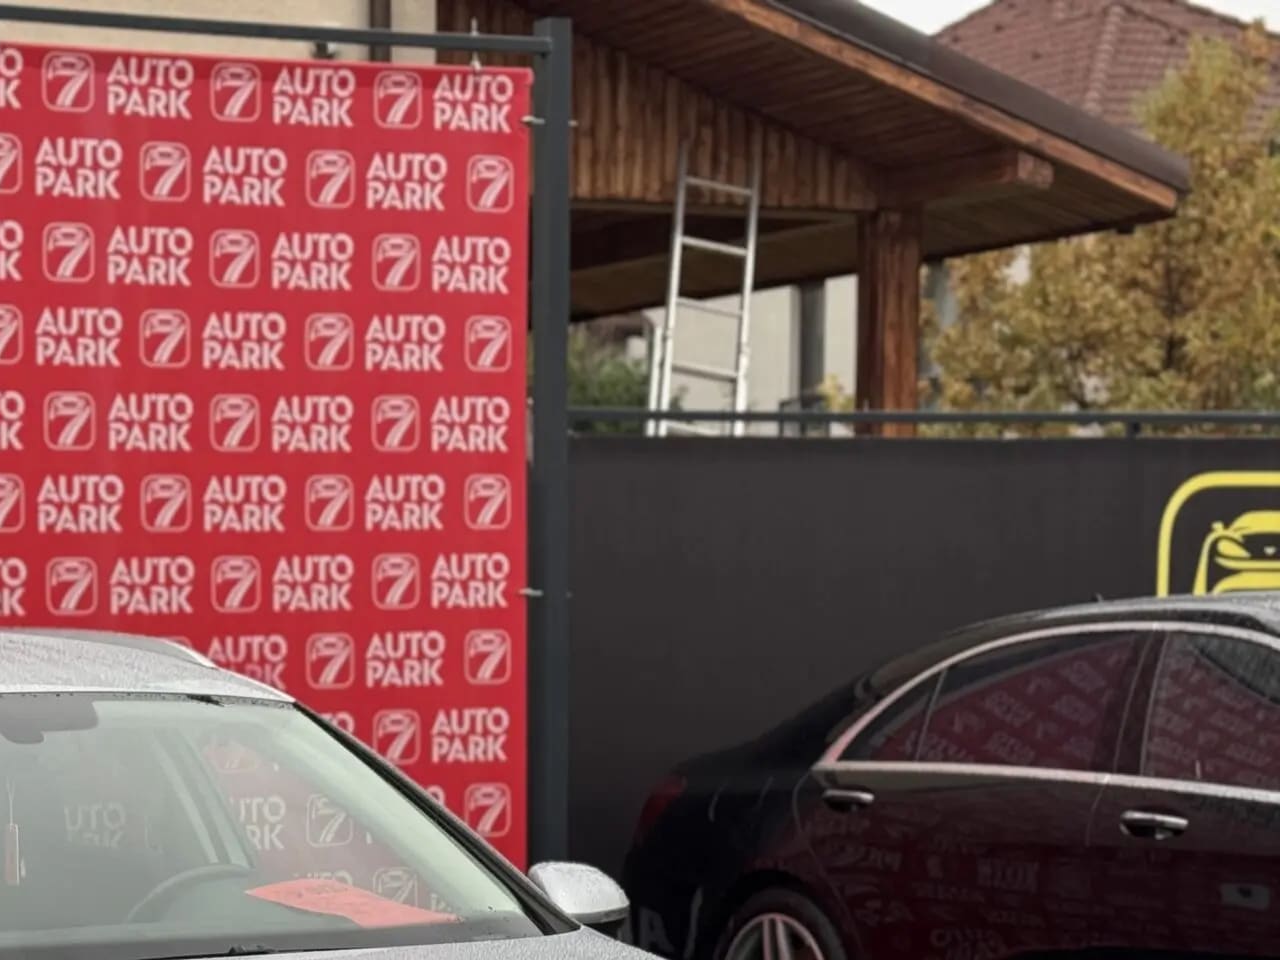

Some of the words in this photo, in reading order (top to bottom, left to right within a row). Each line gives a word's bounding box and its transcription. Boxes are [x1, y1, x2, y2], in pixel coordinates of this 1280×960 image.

[107, 56, 194, 89] AUTO
[272, 66, 355, 99] AUTO
[434, 73, 514, 102] AUTO
[107, 84, 192, 120] PARK
[273, 94, 353, 128] PARK
[434, 102, 512, 134] PARK
[35, 138, 122, 168] AUTO
[204, 146, 288, 175] AUTO
[366, 153, 448, 182] AUTO
[36, 165, 121, 199] PARK
[204, 174, 285, 208] PARK
[366, 180, 445, 212] PARK
[107, 226, 194, 256] AUTO
[272, 234, 354, 262] AUTO
[432, 237, 512, 265] AUTO
[108, 254, 192, 286] PARK
[272, 260, 352, 291] PARK
[432, 263, 509, 294] PARK
[35, 306, 122, 338] AUTO
[203, 312, 286, 342] AUTO
[365, 314, 446, 344] AUTO
[36, 336, 121, 368] PARK
[203, 340, 285, 371] PARK
[365, 342, 444, 372] PARK
[108, 394, 194, 424] AUTO
[272, 395, 354, 425] AUTO
[430, 396, 510, 425] AUTO
[108, 422, 192, 452] PARK
[272, 423, 352, 454] PARK
[430, 424, 508, 454] PARK
[38, 474, 124, 504] AUTO
[203, 474, 286, 504] AUTO
[365, 474, 445, 502] AUTO
[38, 502, 123, 534] PARK
[204, 502, 285, 533] PARK
[365, 502, 444, 532] PARK
[110, 556, 195, 586] AUTO
[272, 555, 355, 584] AUTO
[431, 553, 510, 582] AUTO
[110, 585, 194, 615] PARK
[273, 583, 354, 614] PARK
[431, 580, 508, 609] PARK
[207, 635, 287, 663] AUTO
[365, 631, 446, 659] AUTO
[366, 657, 444, 688] PARK
[431, 708, 509, 734] AUTO
[431, 734, 507, 763] PARK
